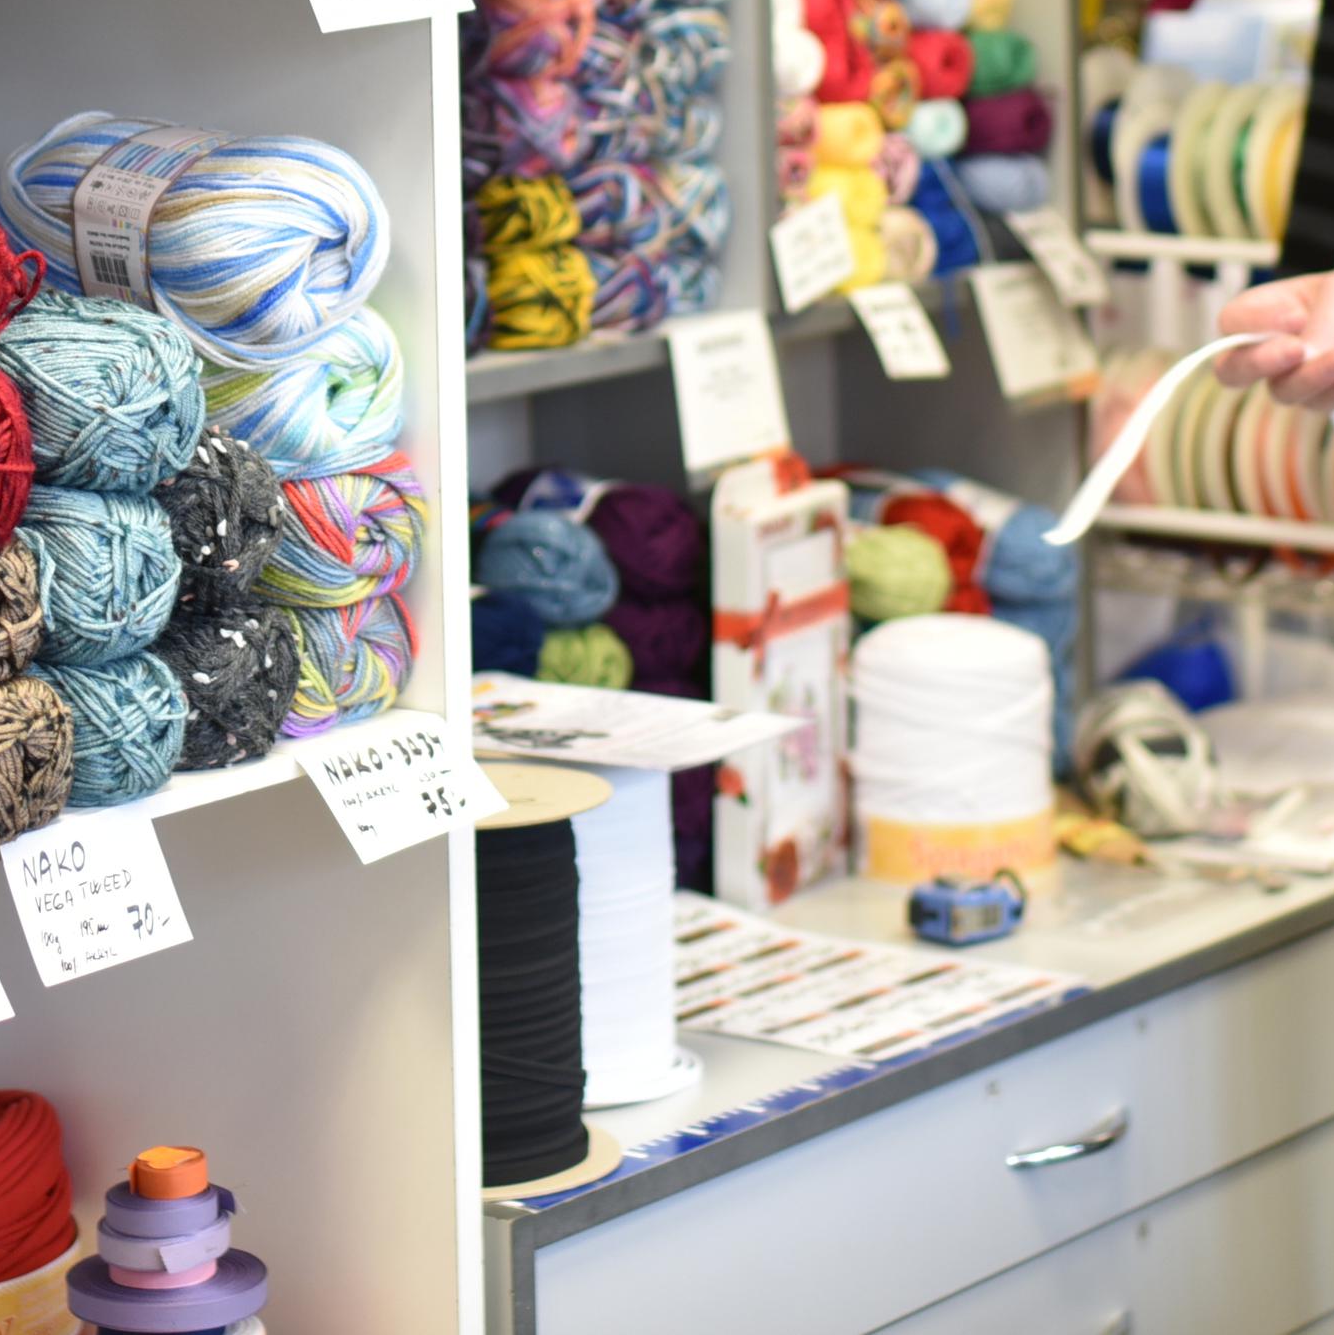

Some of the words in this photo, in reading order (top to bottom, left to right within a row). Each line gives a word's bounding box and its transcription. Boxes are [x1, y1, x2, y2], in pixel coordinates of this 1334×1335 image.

[322, 747, 384, 786] NAKO
[22, 840, 86, 887] NAKO
[35, 889, 74, 914] VEGA
[78, 869, 132, 900] TWEED
